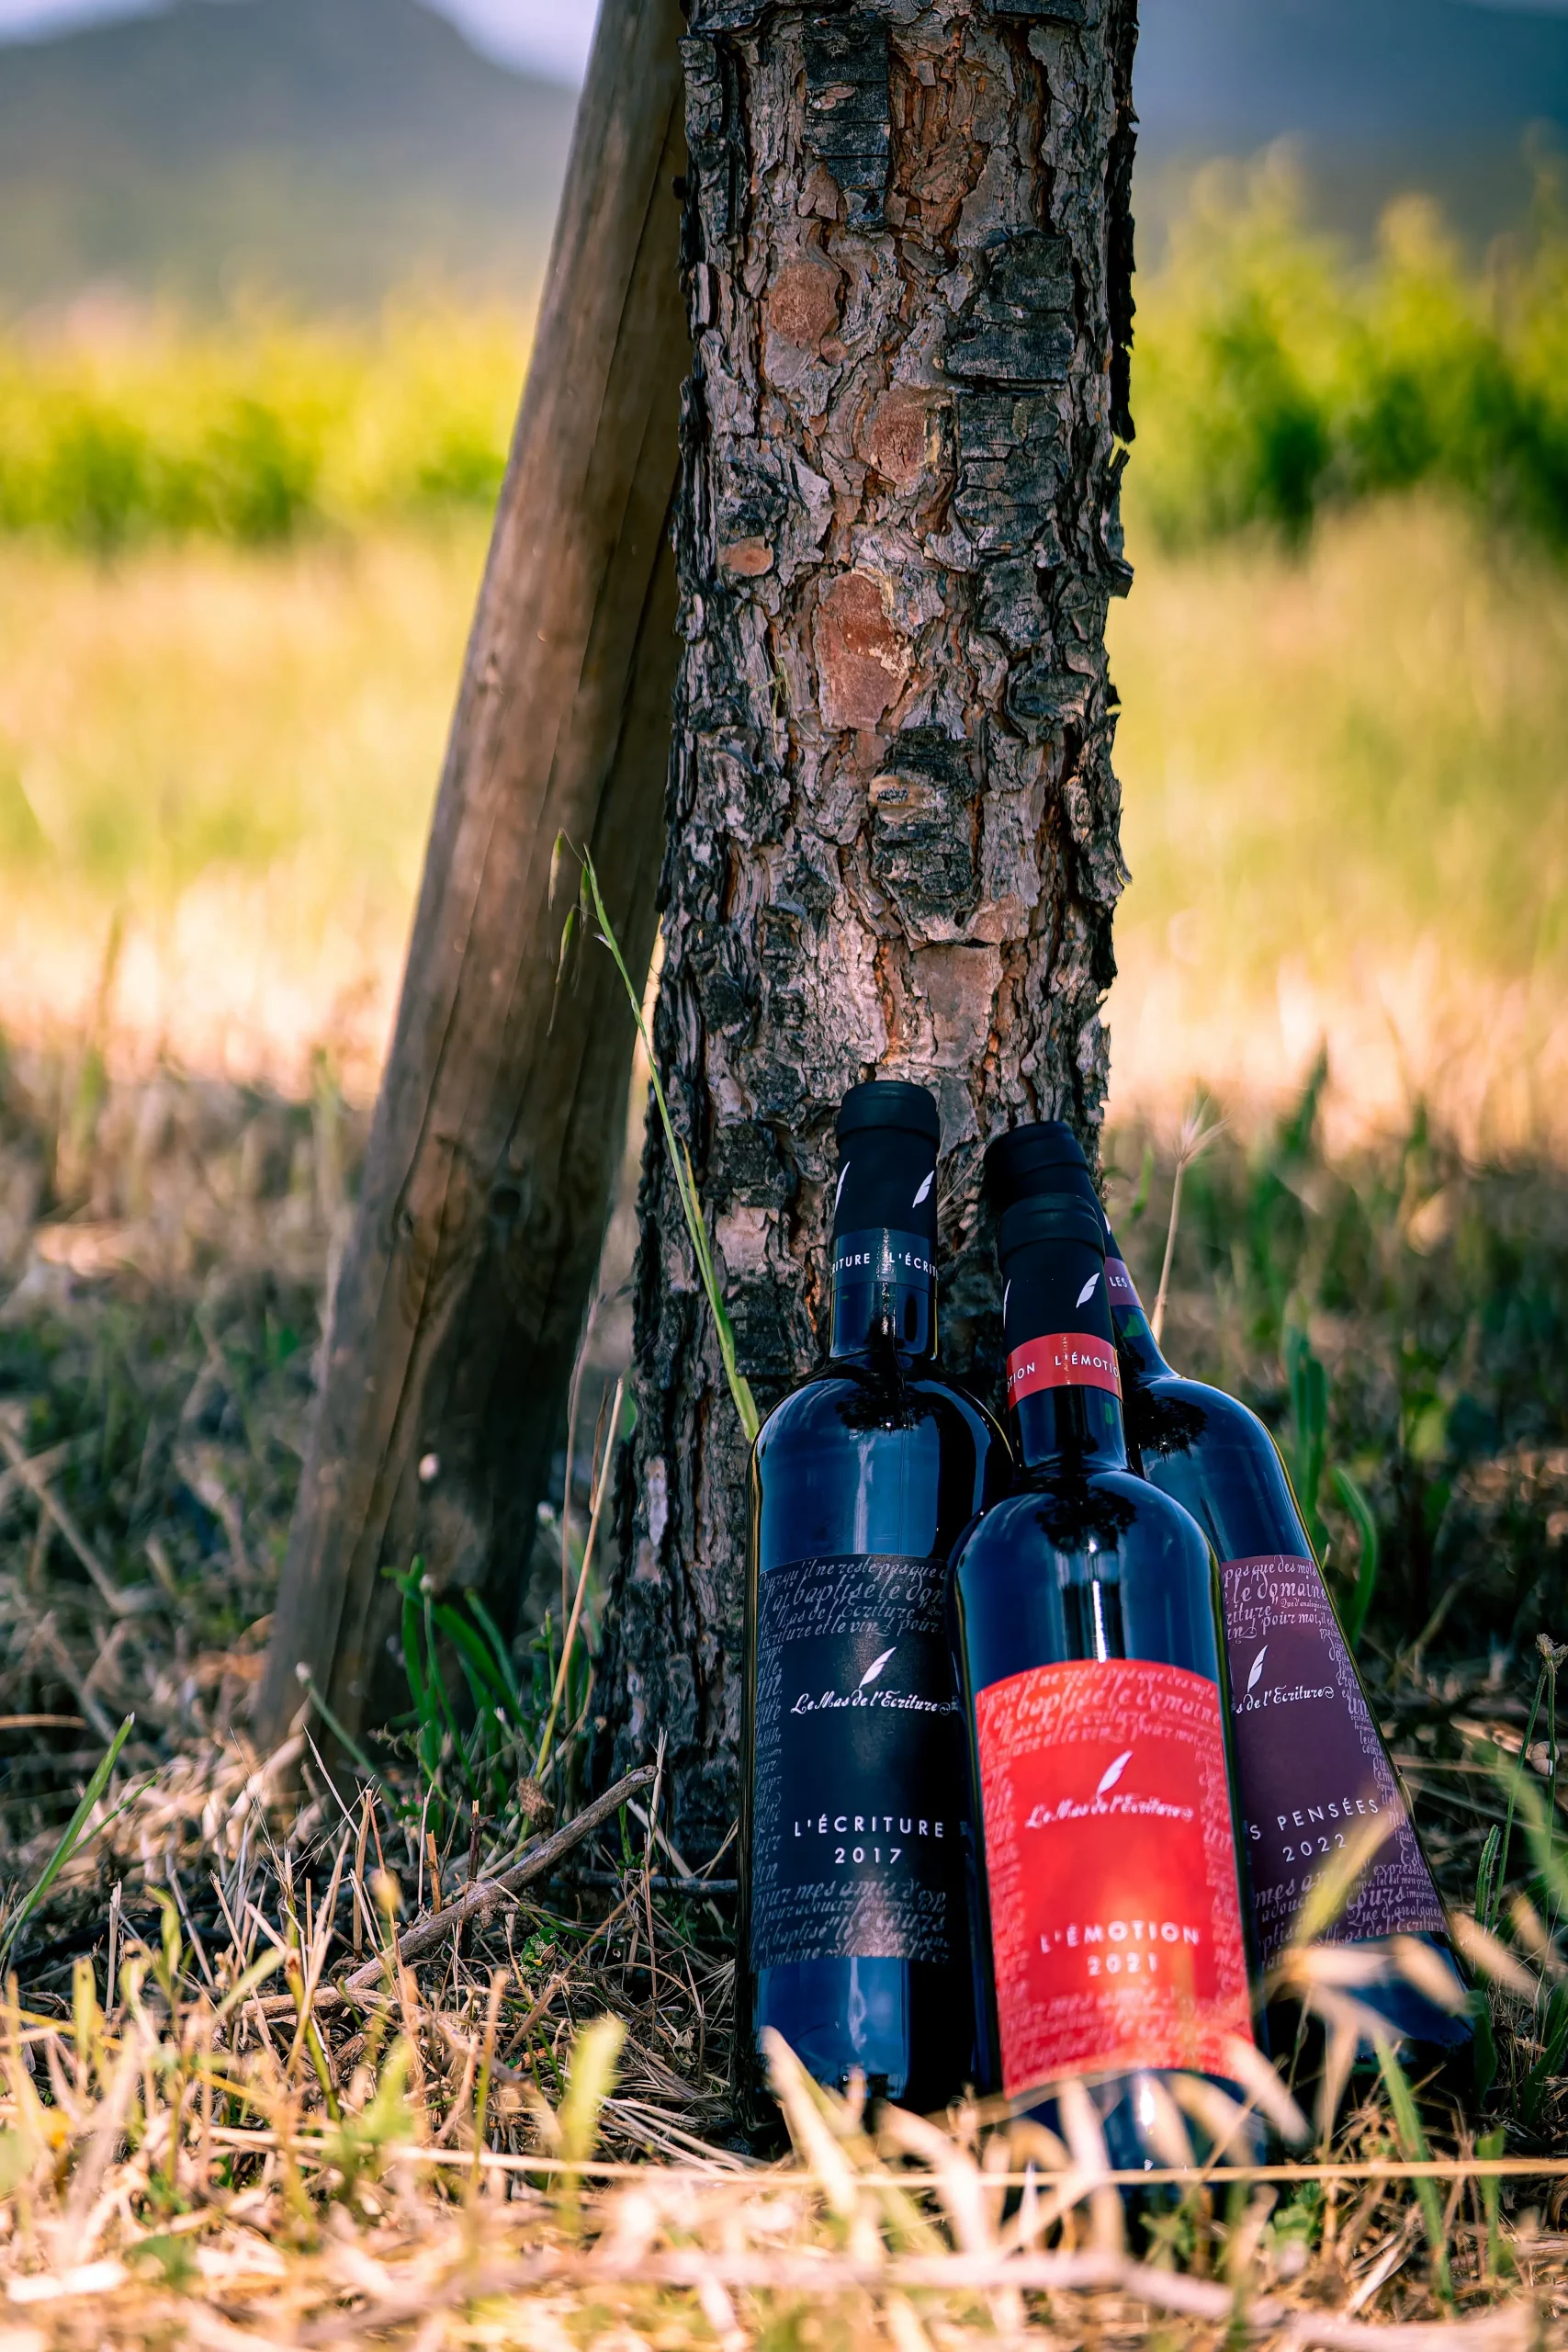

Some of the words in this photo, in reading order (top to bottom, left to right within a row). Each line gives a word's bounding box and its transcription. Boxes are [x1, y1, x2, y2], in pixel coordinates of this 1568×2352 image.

[1110, 1276, 1128, 1288] LES
[790, 1692, 814, 1714] Le
[814, 1690, 852, 1711] Mas
[851, 1688, 868, 1707] de
[1243, 1693, 1261, 1712] de
[795, 1814, 943, 1838] L'ÉCRITURE
[1277, 1798, 1378, 1831] PENSÉES
[835, 1847, 902, 1864] 2017
[1282, 1834, 1347, 1862] 2022
[1040, 1920, 1200, 1954] L'ÉMOTION
[1088, 1951, 1157, 1976] 2021
